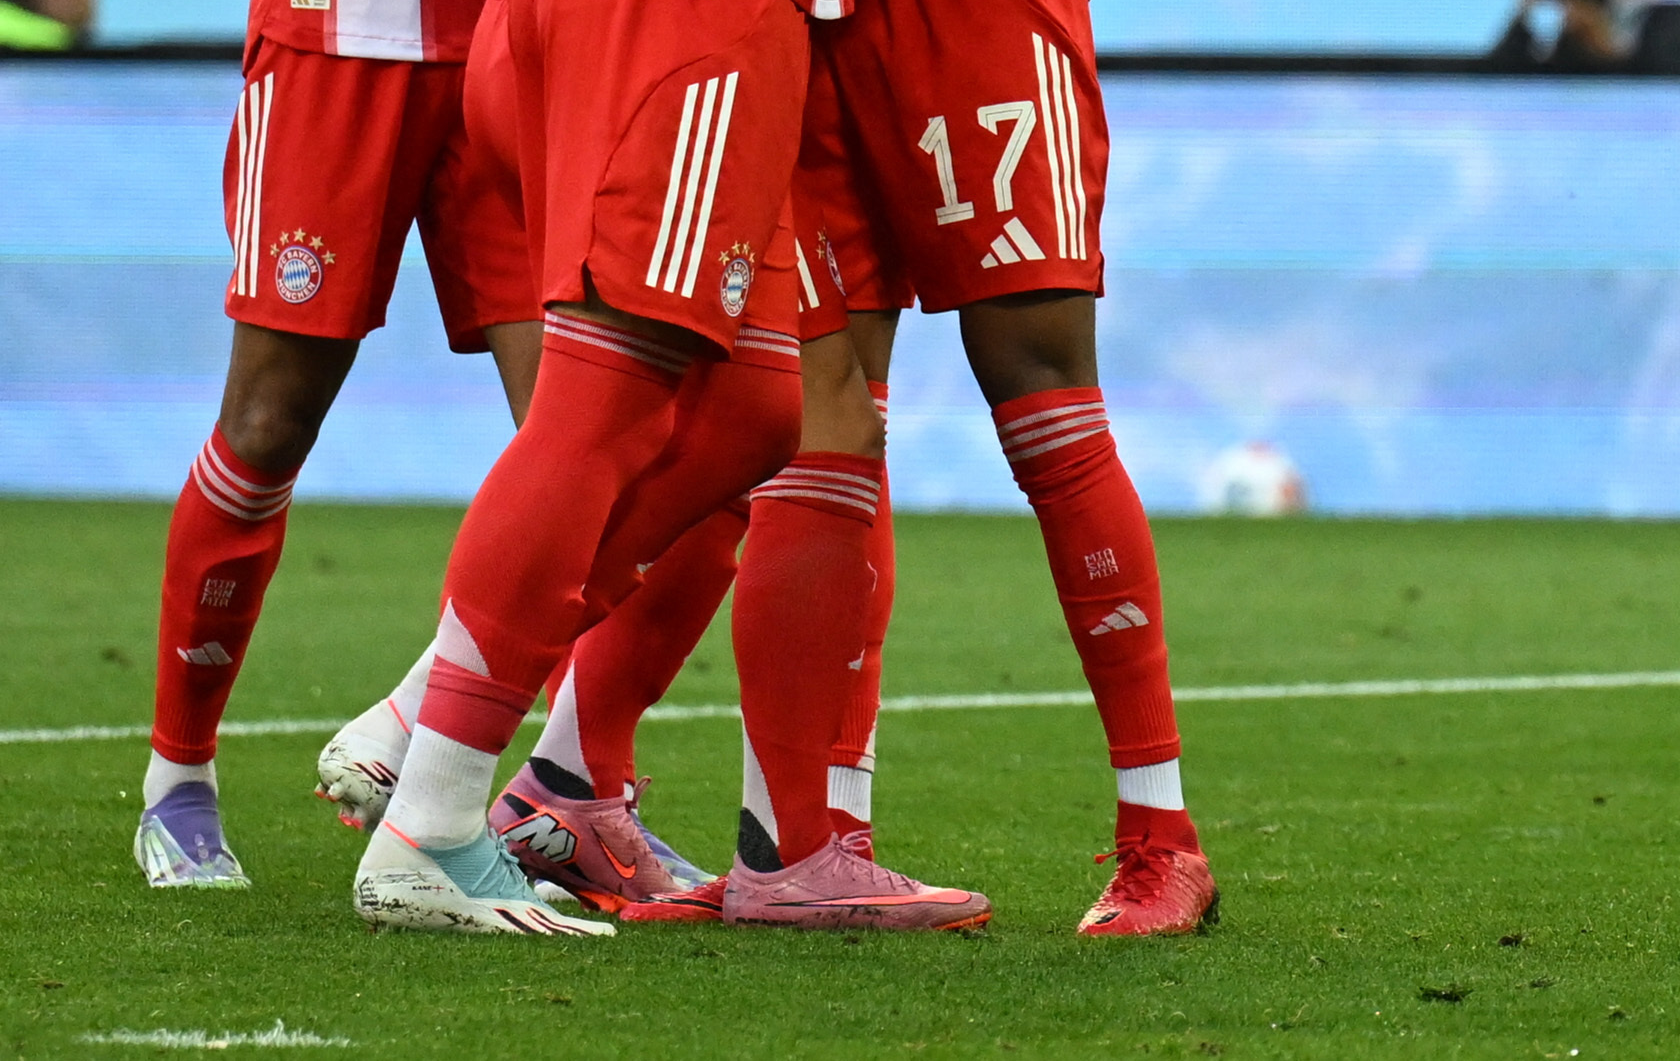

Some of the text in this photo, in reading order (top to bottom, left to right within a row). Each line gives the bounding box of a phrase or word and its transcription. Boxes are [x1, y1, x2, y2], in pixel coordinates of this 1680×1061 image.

[918, 100, 1037, 225] 17
[287, 250, 318, 273] BAYERN
[1084, 548, 1114, 565] MIA
[1089, 565, 1119, 580] MIA
